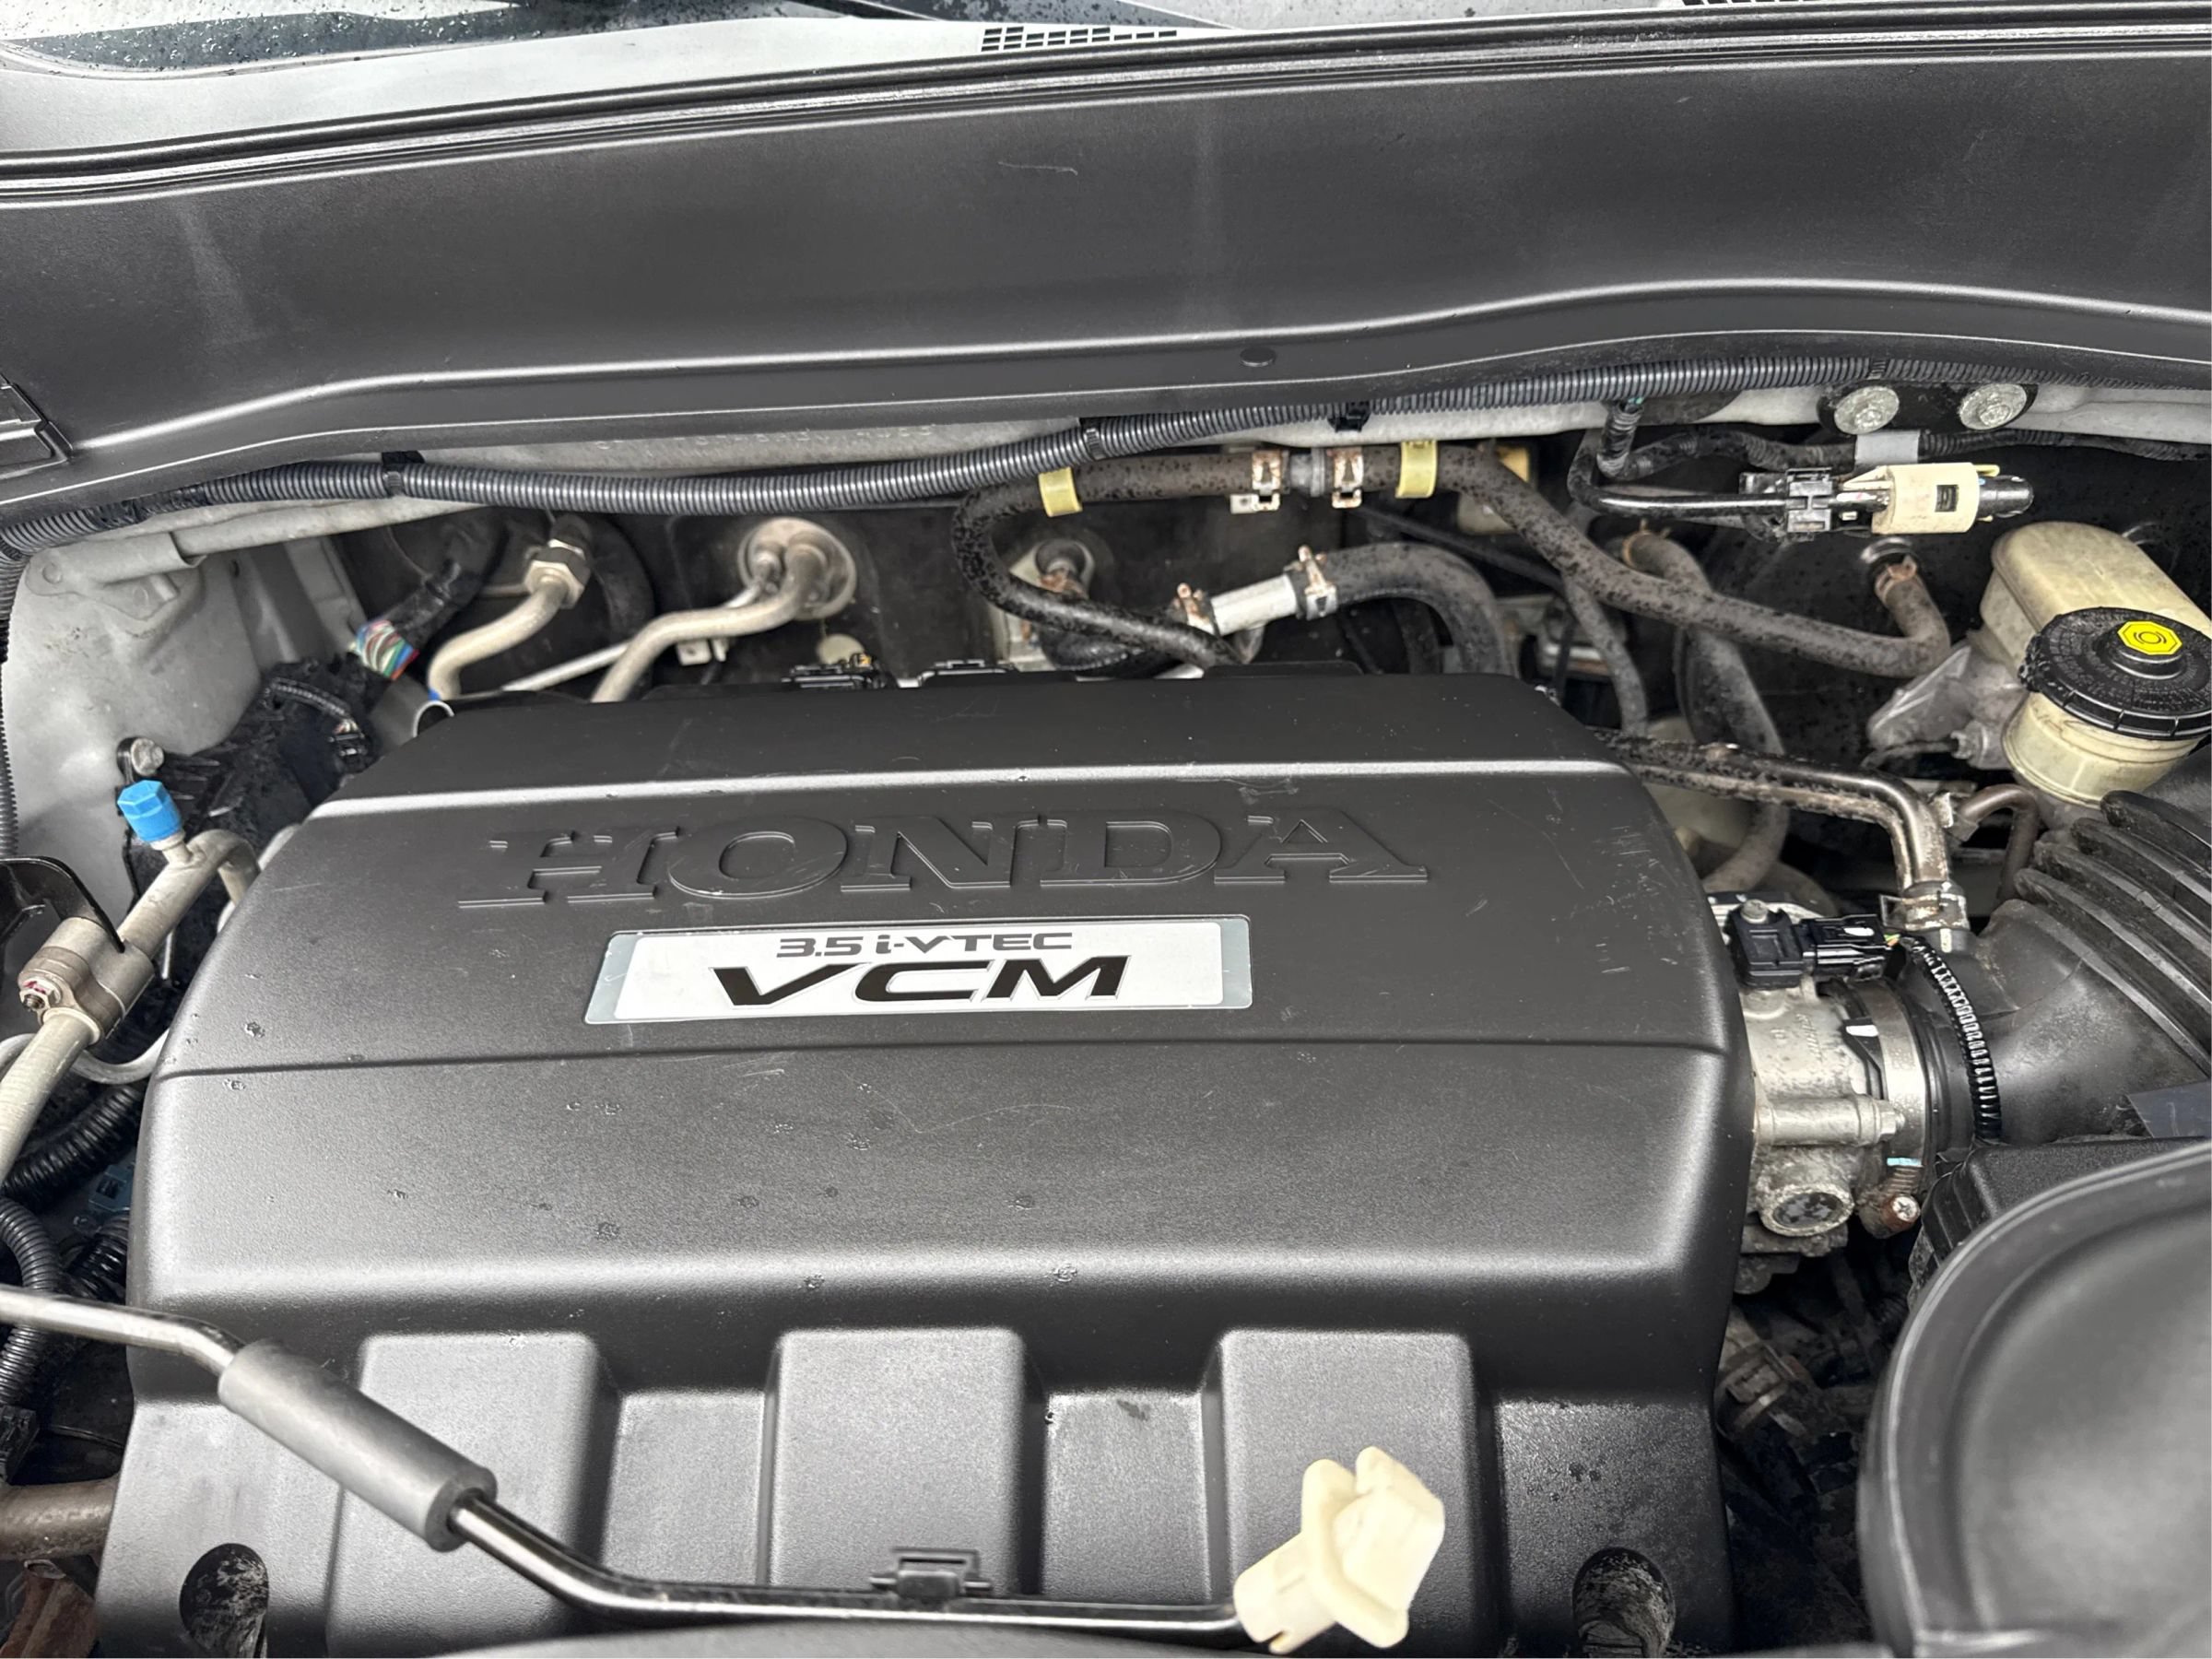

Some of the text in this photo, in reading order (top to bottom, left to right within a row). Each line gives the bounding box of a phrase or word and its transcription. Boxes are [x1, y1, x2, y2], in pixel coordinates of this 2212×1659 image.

[459, 807, 1429, 909] HONDA
[776, 933, 1073, 958] 3.5 i-VTEC
[712, 955, 1131, 1006] VCM
